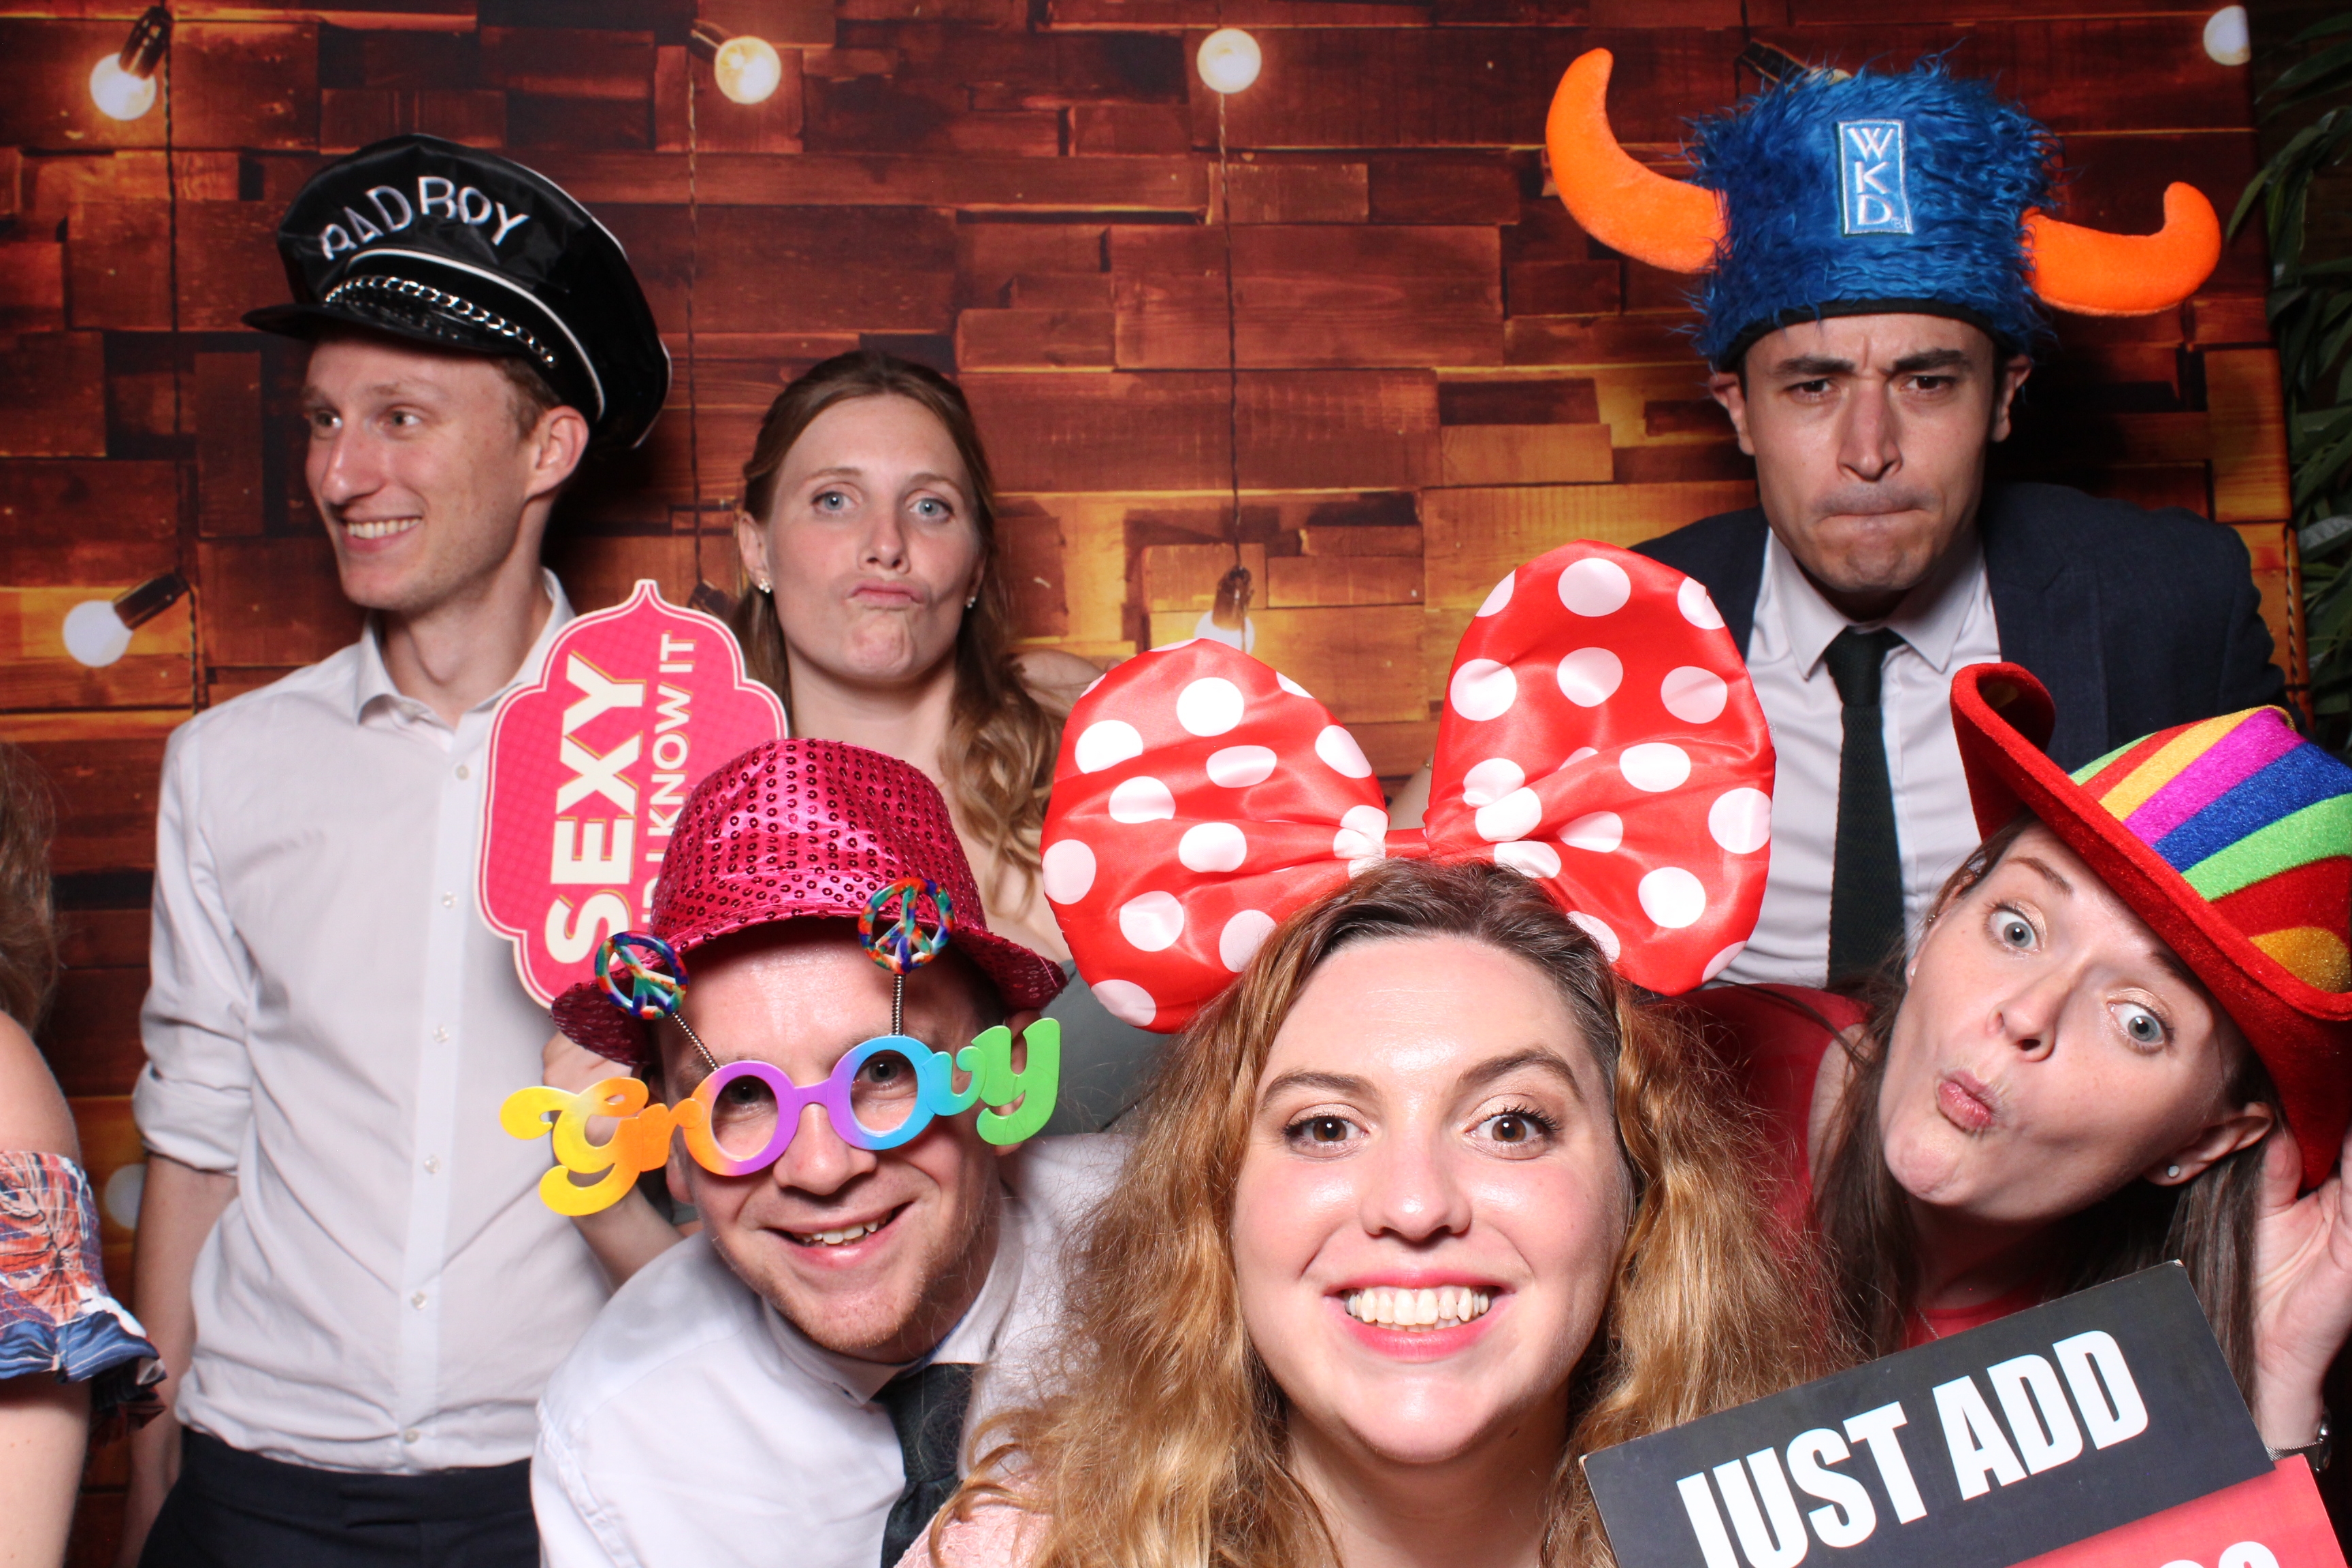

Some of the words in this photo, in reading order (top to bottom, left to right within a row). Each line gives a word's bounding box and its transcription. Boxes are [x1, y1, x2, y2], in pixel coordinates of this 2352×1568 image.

[1846, 127, 1896, 225] WKD
[658, 630, 697, 673] IT
[544, 650, 647, 966] SEXY
[647, 683, 692, 836] KNOW
[1676, 1401, 1928, 1568] JUST
[1932, 1330, 2149, 1501] ADD
